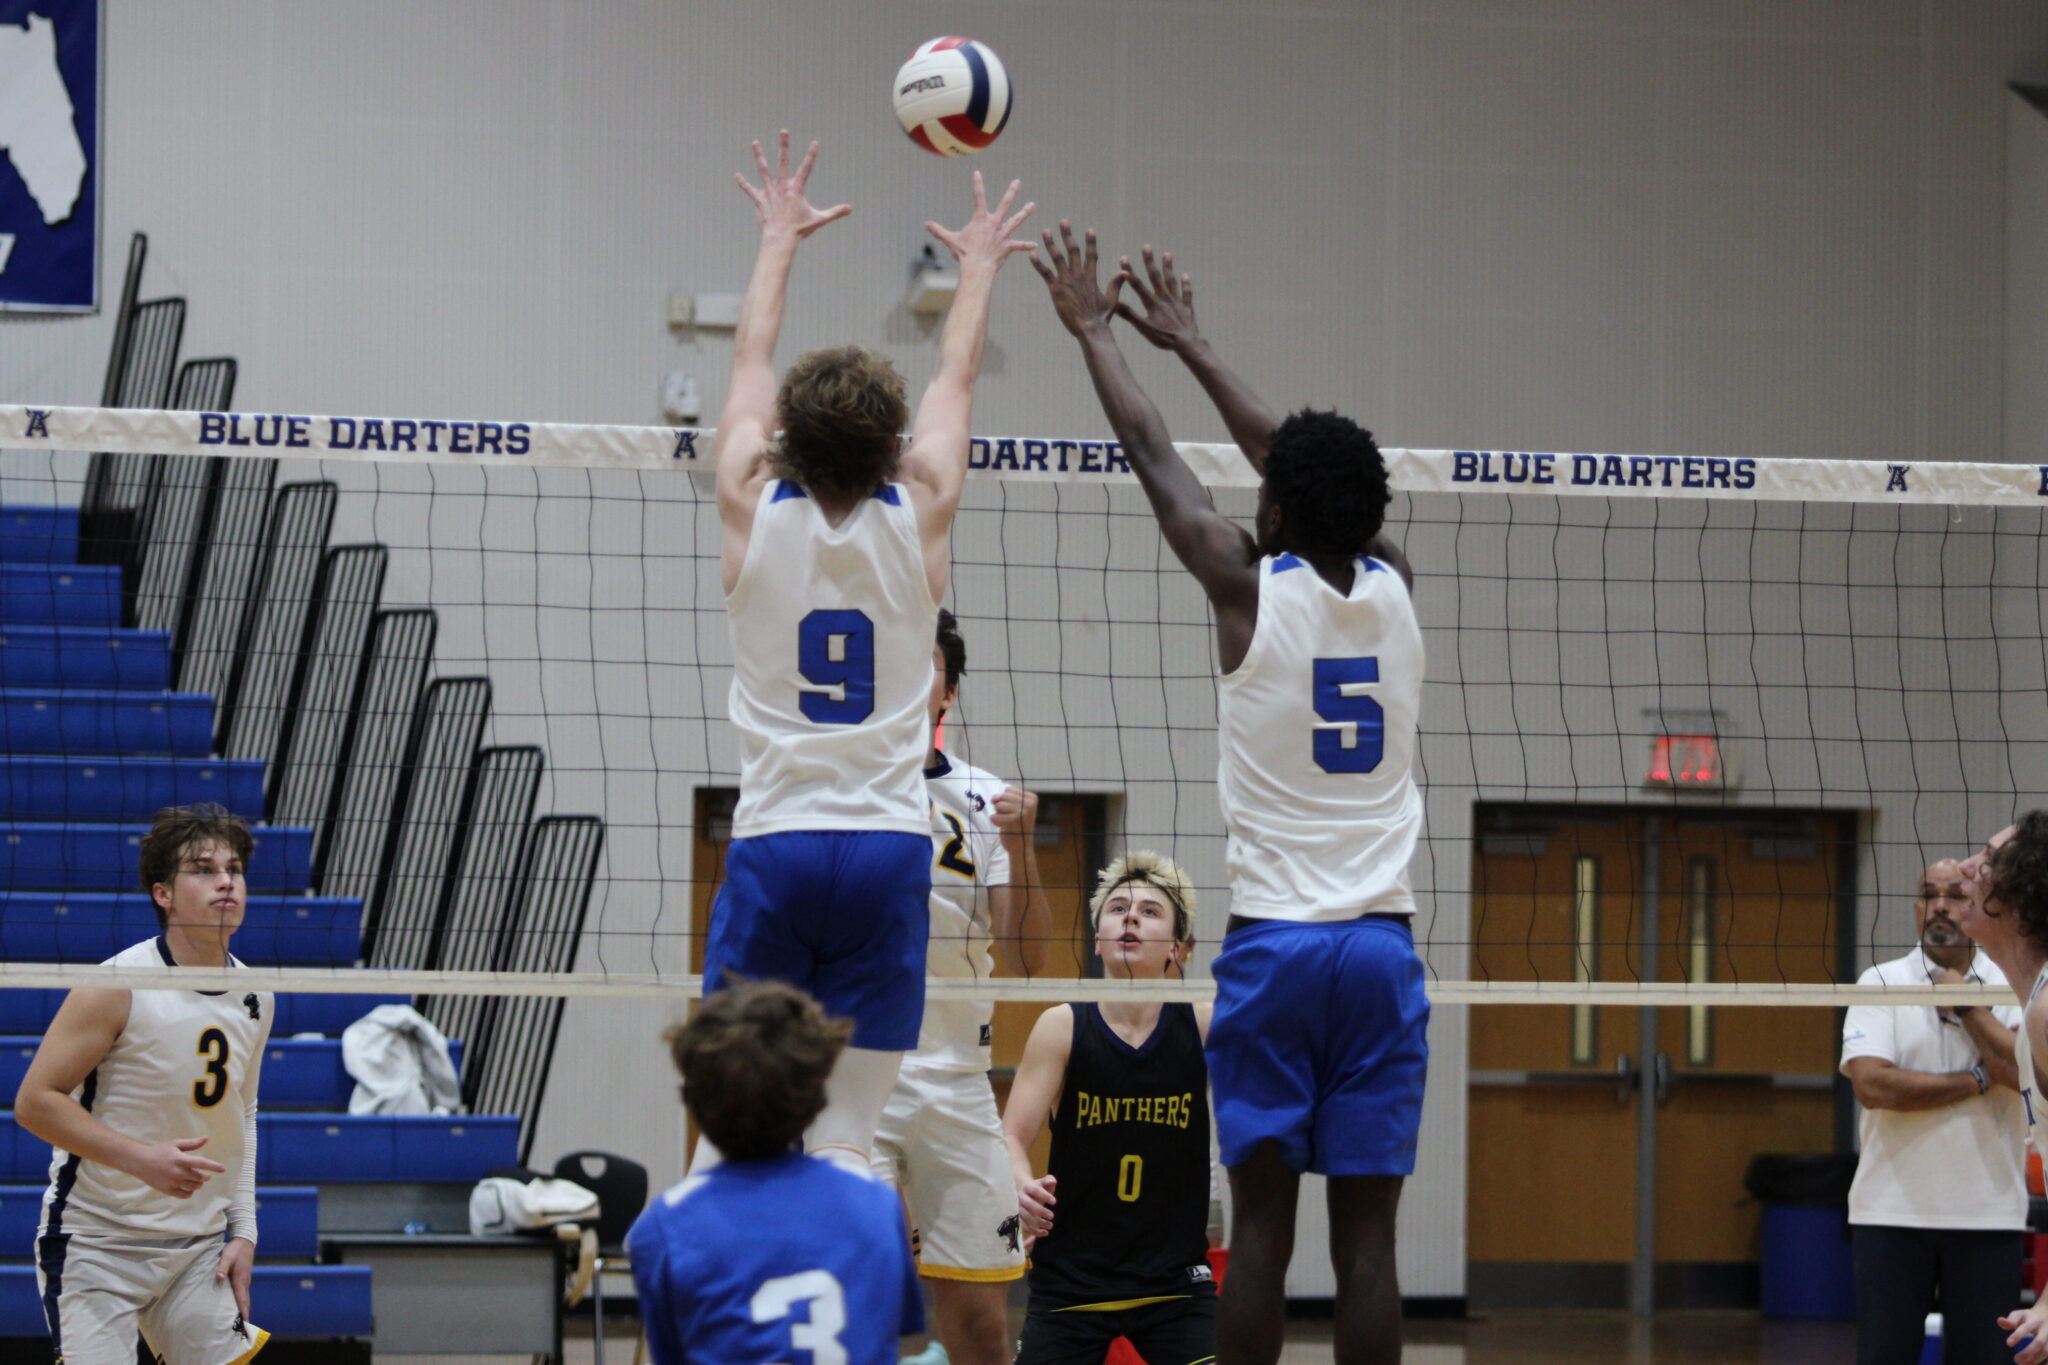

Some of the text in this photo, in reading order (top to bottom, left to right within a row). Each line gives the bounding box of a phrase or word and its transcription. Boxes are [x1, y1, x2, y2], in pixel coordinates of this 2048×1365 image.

[198, 413, 530, 455] BLUE DARTERS
[968, 438, 1130, 473] DARTER
[1452, 451, 1757, 489] BLUE DARTERS
[798, 608, 875, 725] 9
[1312, 656, 1384, 774] 5
[192, 1025, 230, 1110] 3
[1076, 1091, 1192, 1129] PANTHERS
[1117, 1154, 1143, 1202] 0
[749, 1268, 850, 1365] 3
